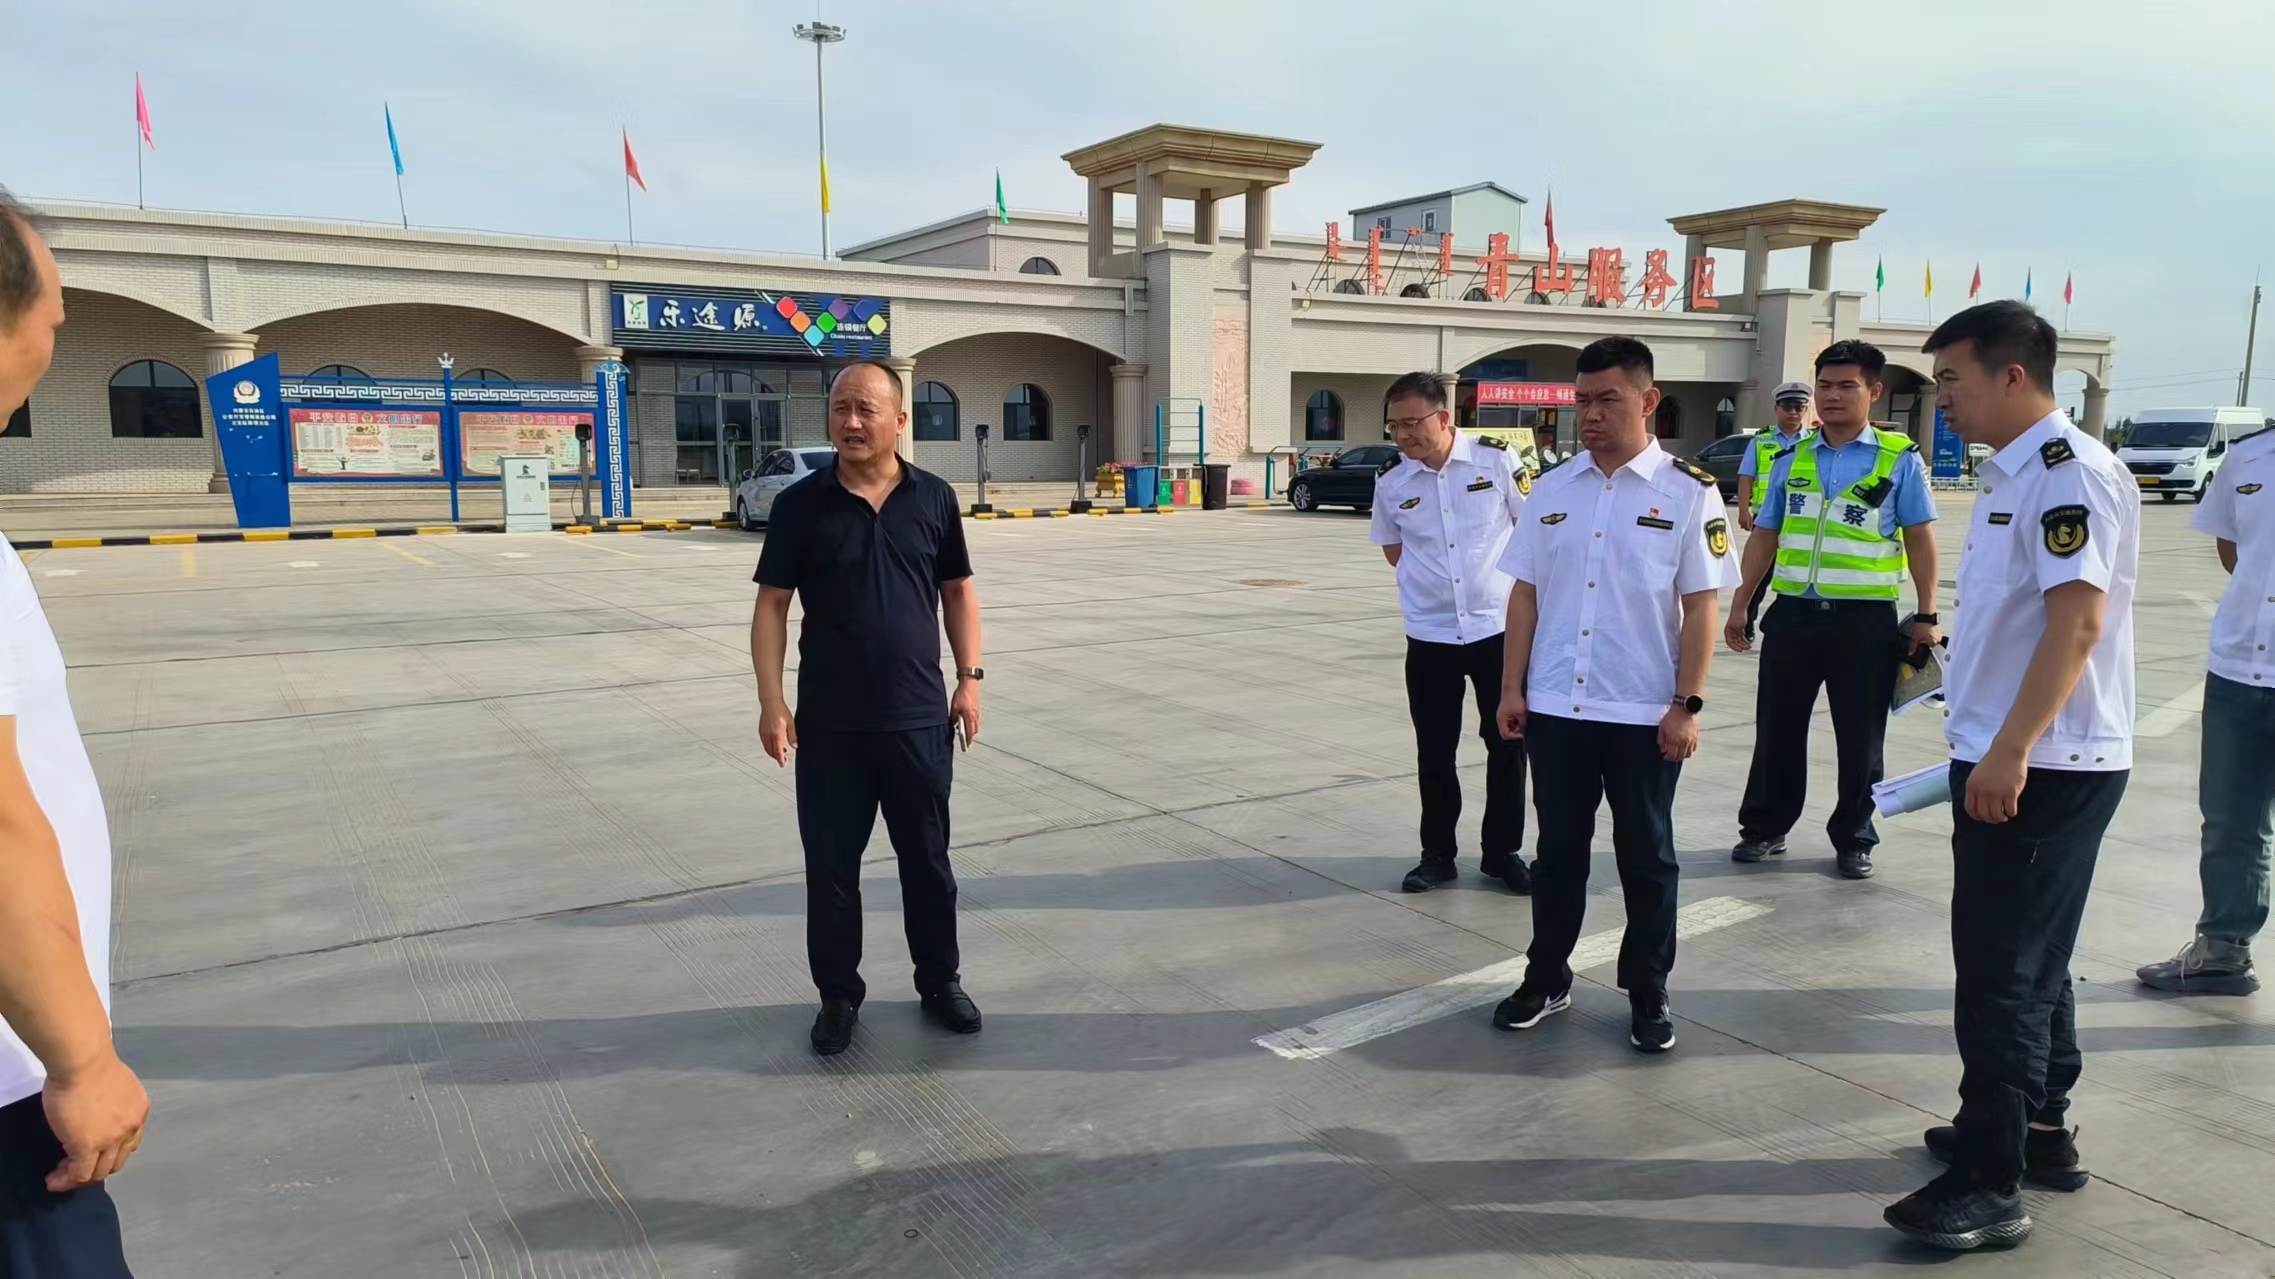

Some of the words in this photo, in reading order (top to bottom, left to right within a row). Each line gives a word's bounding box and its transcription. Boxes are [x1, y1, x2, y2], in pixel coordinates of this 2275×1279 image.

[1475, 232, 1720, 309] 青山服务区
[659, 299, 760, 331] 乐途源
[836, 322, 867, 333] 连锁餐厅
[1481, 387, 1514, 400] 人人讲安全
[1789, 493, 1806, 515] 警
[1843, 504, 1868, 527] 察
